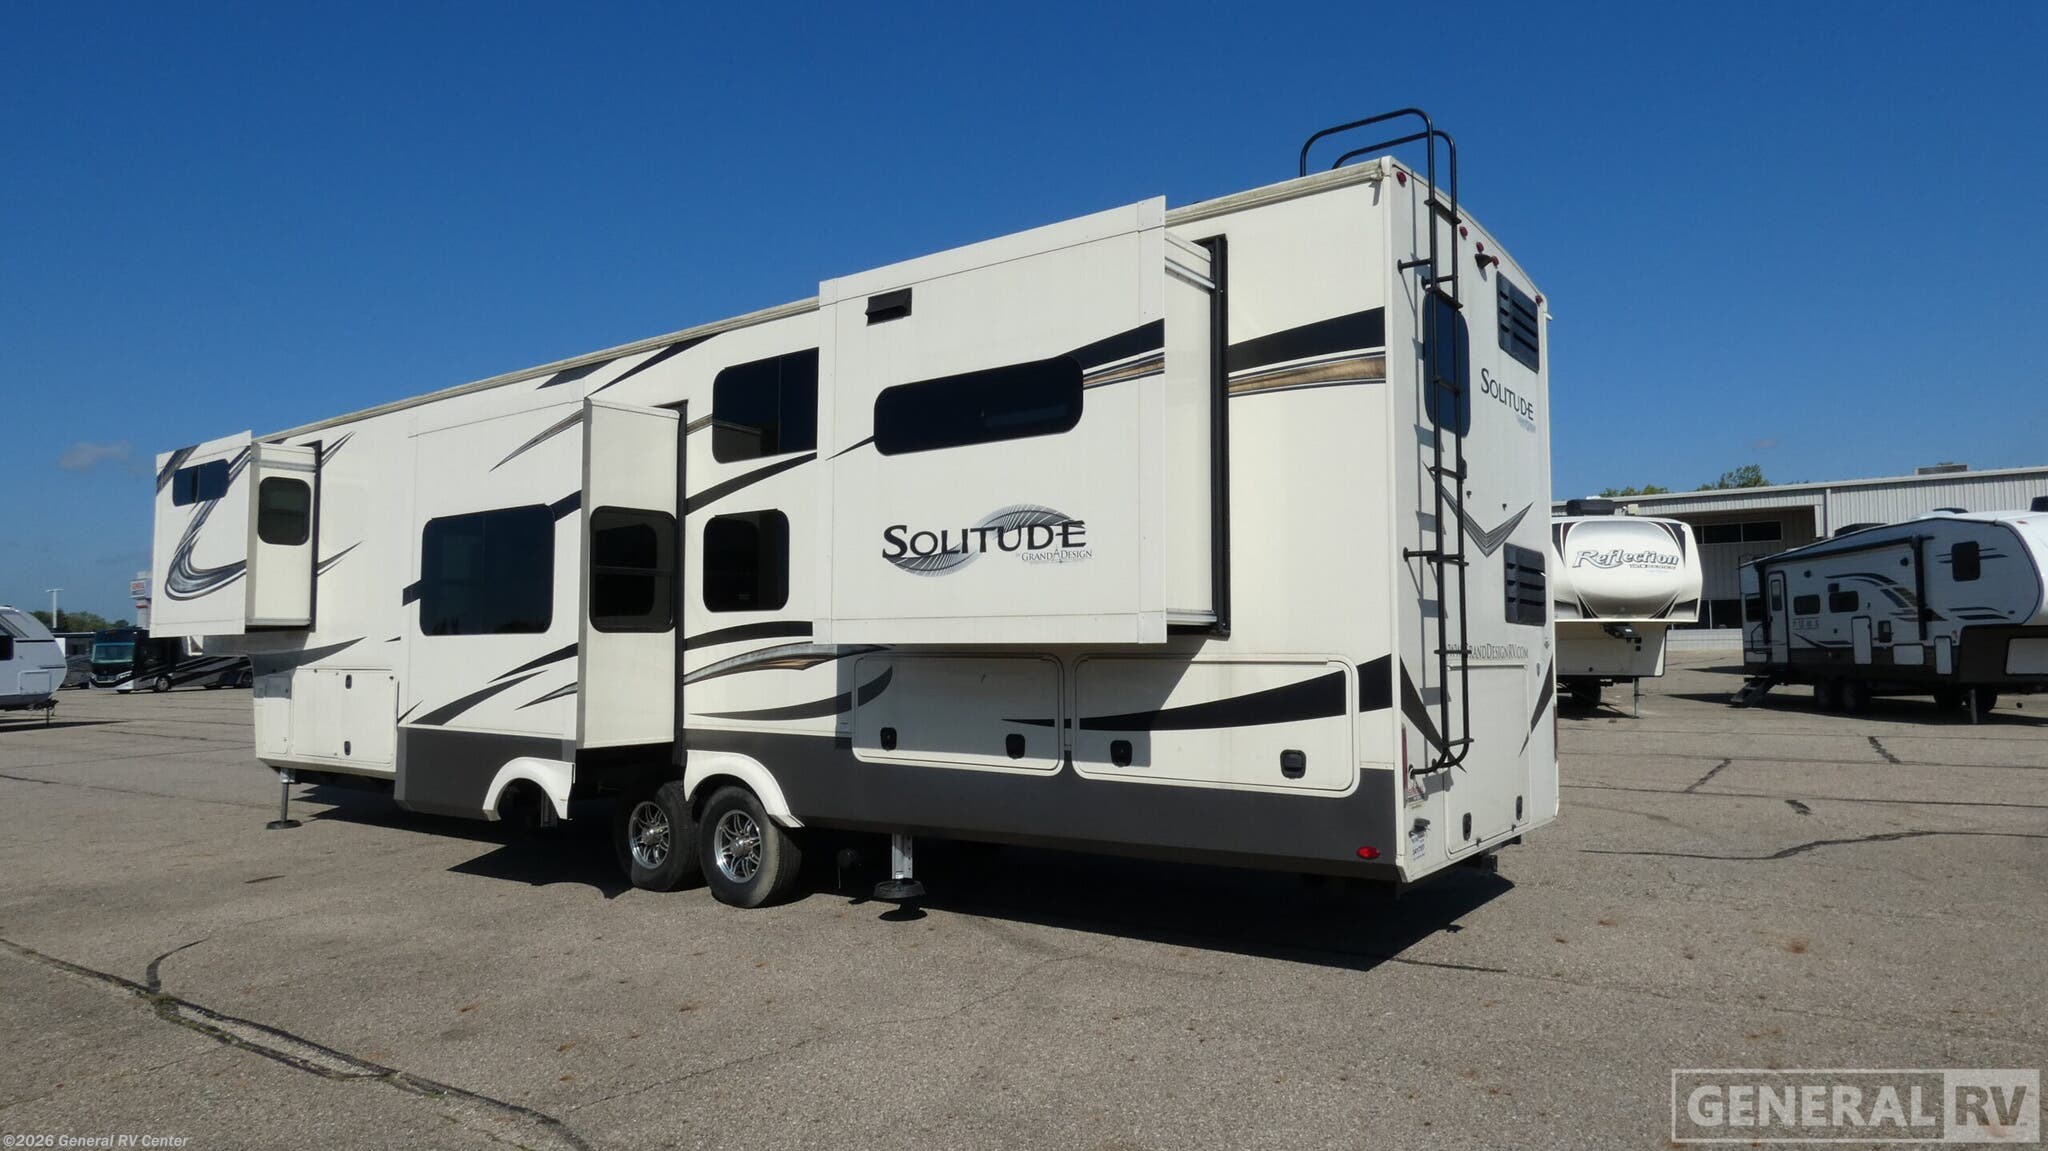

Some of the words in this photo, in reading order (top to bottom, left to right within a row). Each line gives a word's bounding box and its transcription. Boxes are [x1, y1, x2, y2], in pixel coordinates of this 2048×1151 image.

[1481, 368, 1534, 421] SOLITUDE
[882, 520, 1087, 560] SOLITUDE
[1572, 549, 1680, 570] Reflection
